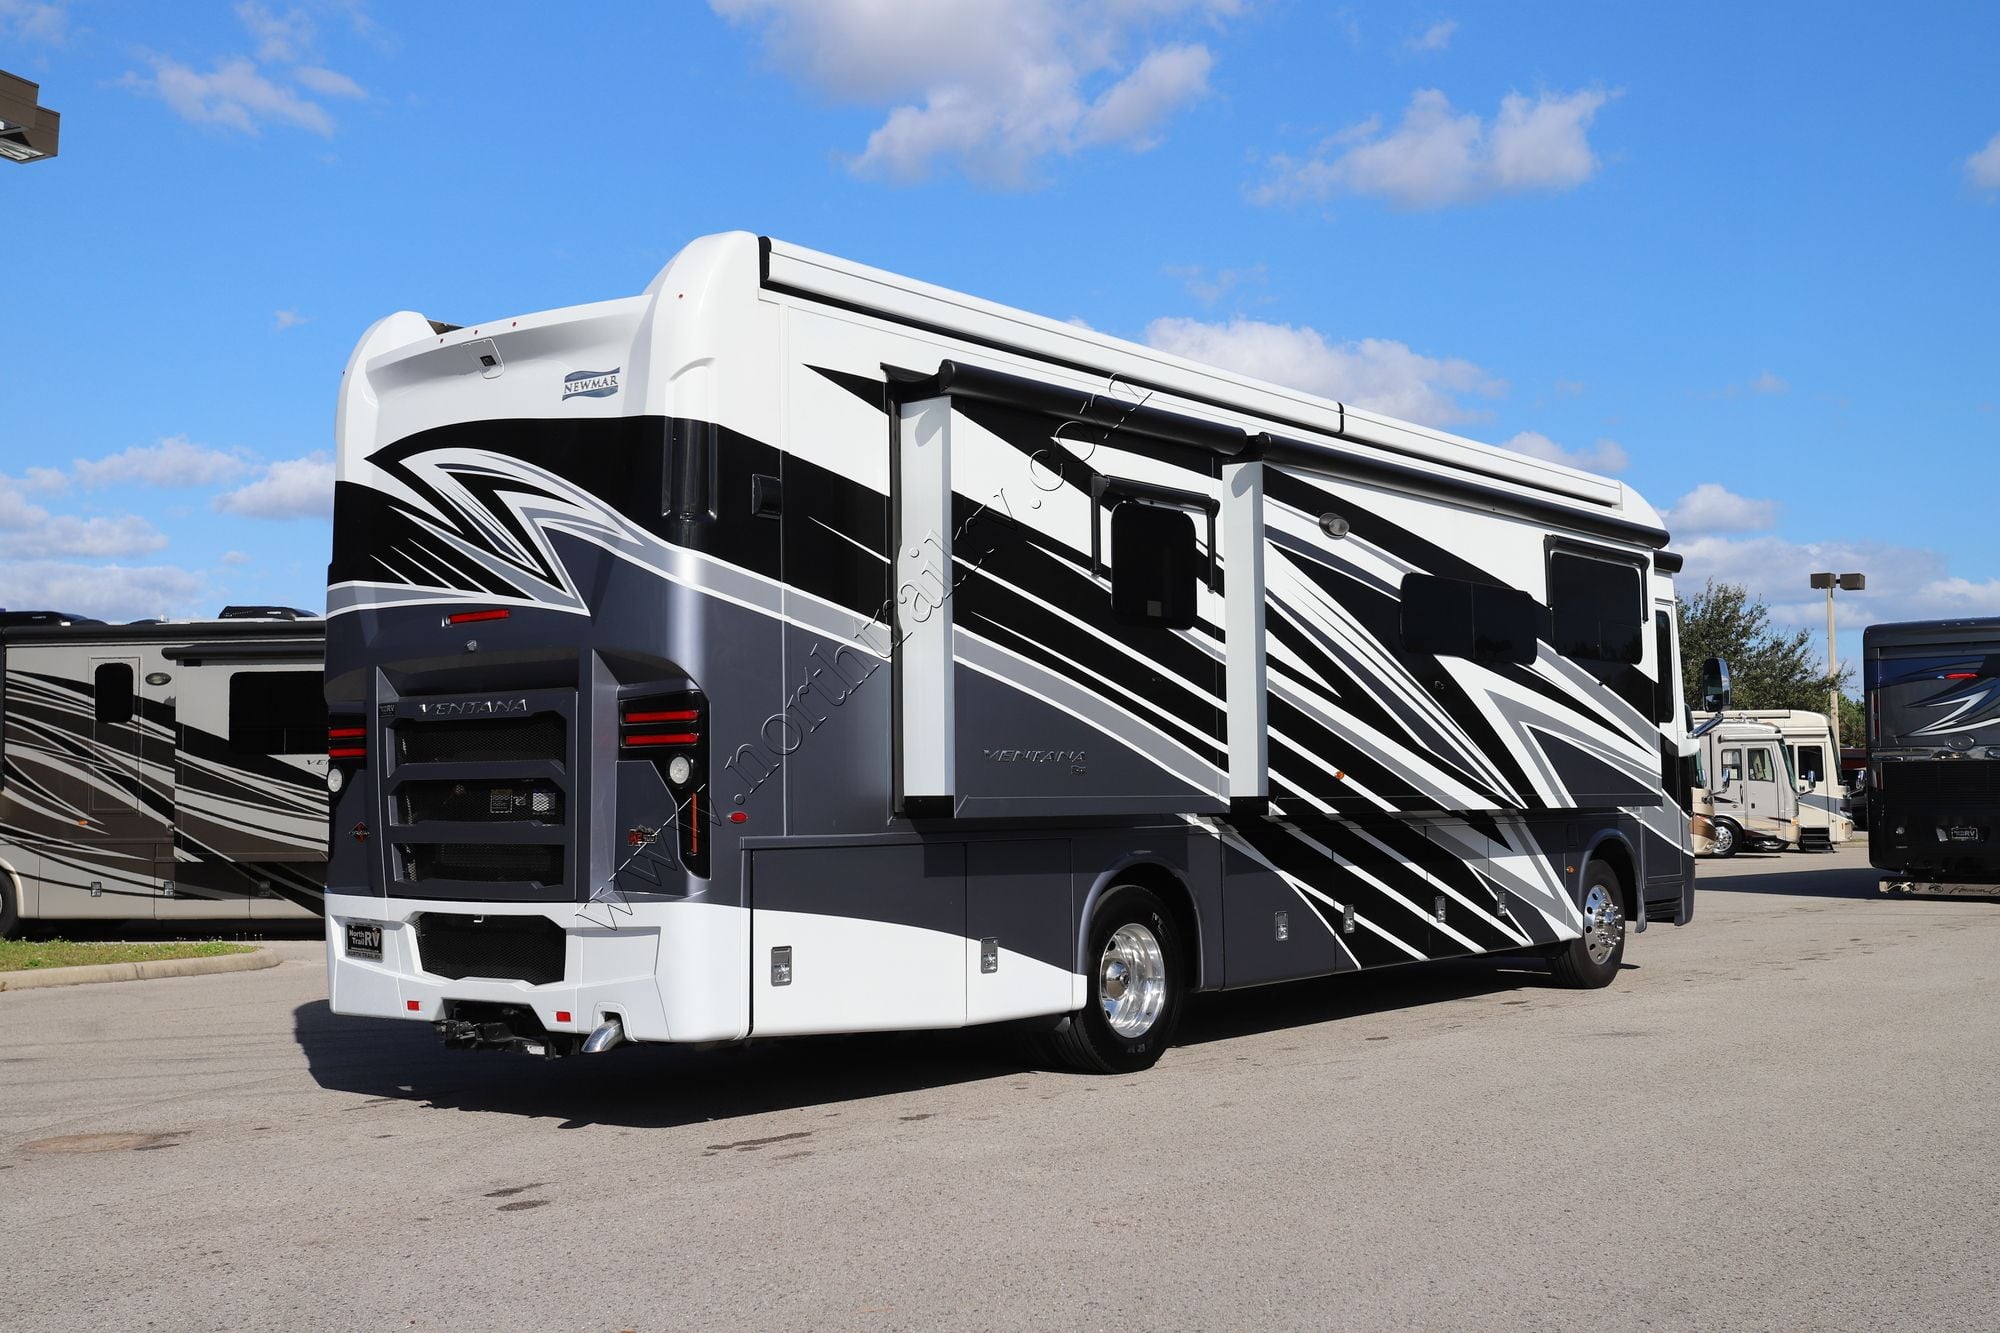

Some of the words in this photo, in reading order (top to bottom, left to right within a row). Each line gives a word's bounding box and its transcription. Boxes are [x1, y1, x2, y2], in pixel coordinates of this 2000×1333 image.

[564, 375, 618, 393] NEWMAR
[419, 699, 527, 714] VENTANA
[984, 749, 1086, 763] VENTANA
[349, 929, 365, 938] North
[365, 931, 380, 947] RV
